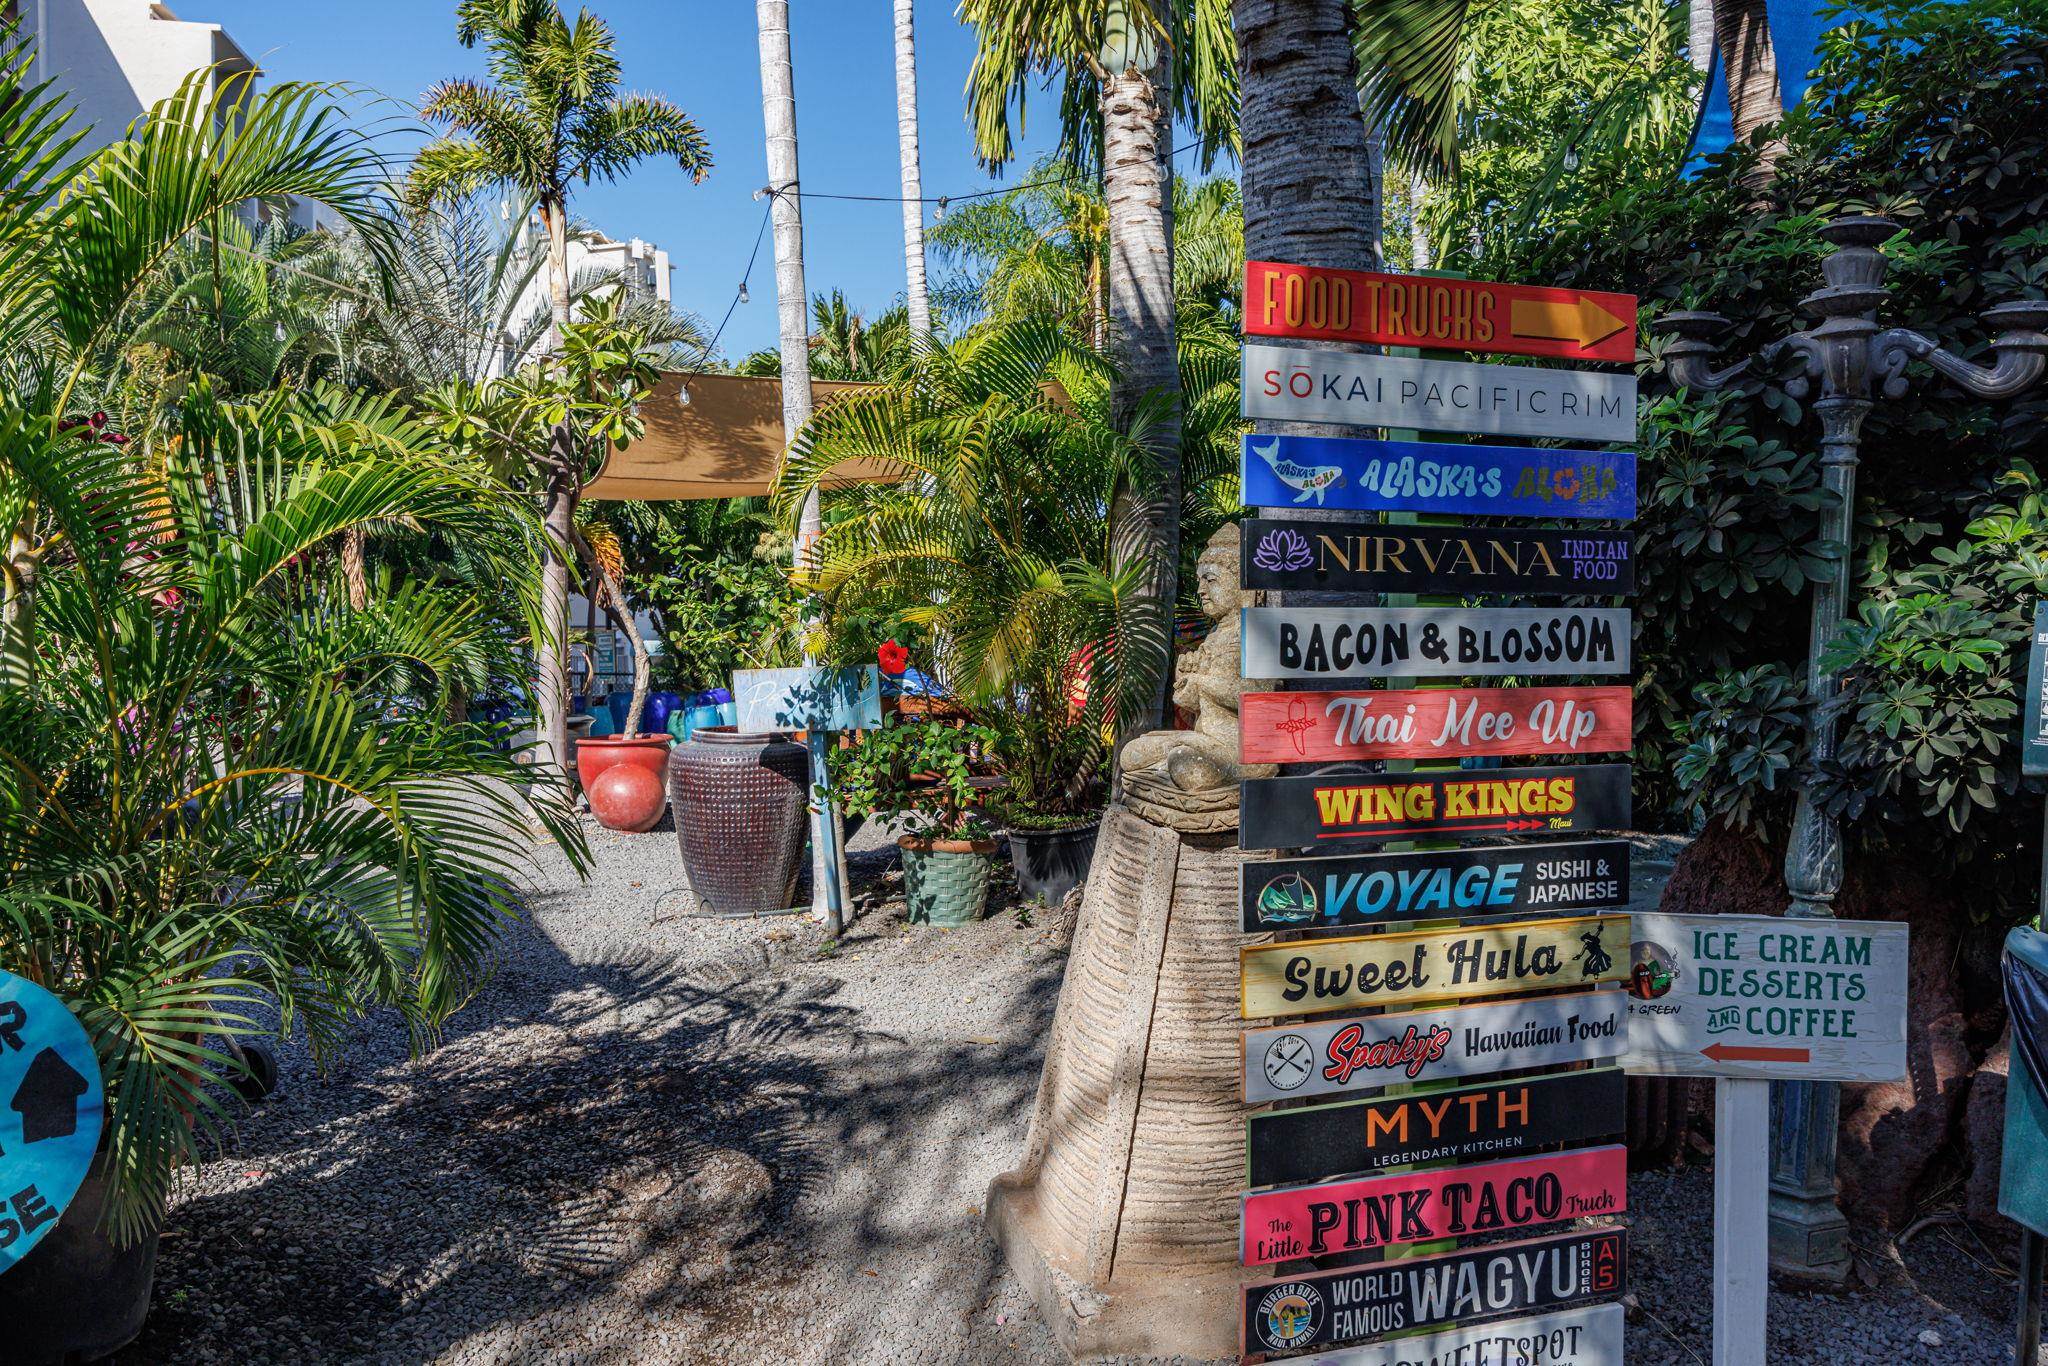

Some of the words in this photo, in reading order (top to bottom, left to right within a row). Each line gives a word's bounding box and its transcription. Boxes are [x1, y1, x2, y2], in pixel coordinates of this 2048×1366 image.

[1263, 271, 1352, 331] FOOD
[1366, 280, 1496, 343] TRUCKS
[1401, 380, 1547, 414] PACIFIC
[1562, 392, 1621, 418] RIM
[1302, 470, 1335, 489] ALOHA
[1359, 456, 1502, 499] ALASKA'S
[1512, 464, 1618, 503] ALOHA
[1316, 534, 1562, 577] NIRVANA
[1561, 539, 1629, 561] INDIAN
[1573, 560, 1618, 580] FOOD
[1280, 622, 1410, 672] BACON
[1420, 622, 1450, 664] &
[1458, 615, 1615, 663] BLOSSOM
[1325, 697, 1418, 747] Thai
[1430, 696, 1516, 748] Mee
[1528, 699, 1596, 750] Up
[1313, 782, 1436, 826] WING
[1443, 777, 1575, 818] KINGS
[1549, 817, 1573, 830] Maui
[1536, 860, 1591, 880] SUSHI
[1596, 859, 1610, 876] &
[1323, 863, 1525, 917] VOYAGE
[1527, 880, 1618, 905] JAPANESE
[1693, 930, 1740, 961] ICE
[1759, 933, 1873, 966] CREAM
[1282, 944, 1430, 1002] Sweet
[1447, 934, 1563, 985] Hula
[1698, 967, 1866, 1001] DESSERTS
[1639, 1004, 1682, 1016] GREEN
[1707, 1009, 1741, 1028] AND
[1746, 1007, 1858, 1038] COFFEE
[1322, 1022, 1453, 1084] Sparky's
[1465, 1021, 1564, 1057] Hawaiian
[1567, 1012, 1618, 1041] Food
[1366, 1088, 1529, 1148] MYTH
[1373, 1144, 1459, 1167] LEGENDARY
[1463, 1136, 1523, 1154] KITCHEN
[1307, 1188, 1432, 1254] PINK
[1441, 1172, 1563, 1234] TACO
[1565, 1189, 1616, 1214] Truck
[1268, 1218, 1293, 1234] The
[1257, 1235, 1304, 1261] Little
[1409, 1245, 1578, 1323] WAGYU
[1581, 1242, 1591, 1294] BURGER
[1260, 1284, 1295, 1314] BURGER
[1297, 1283, 1321, 1307] BOYS
[1332, 1271, 1403, 1306] WORLD
[1289, 1326, 1316, 1348] HAWAII
[1333, 1302, 1404, 1340] FAMOUS
